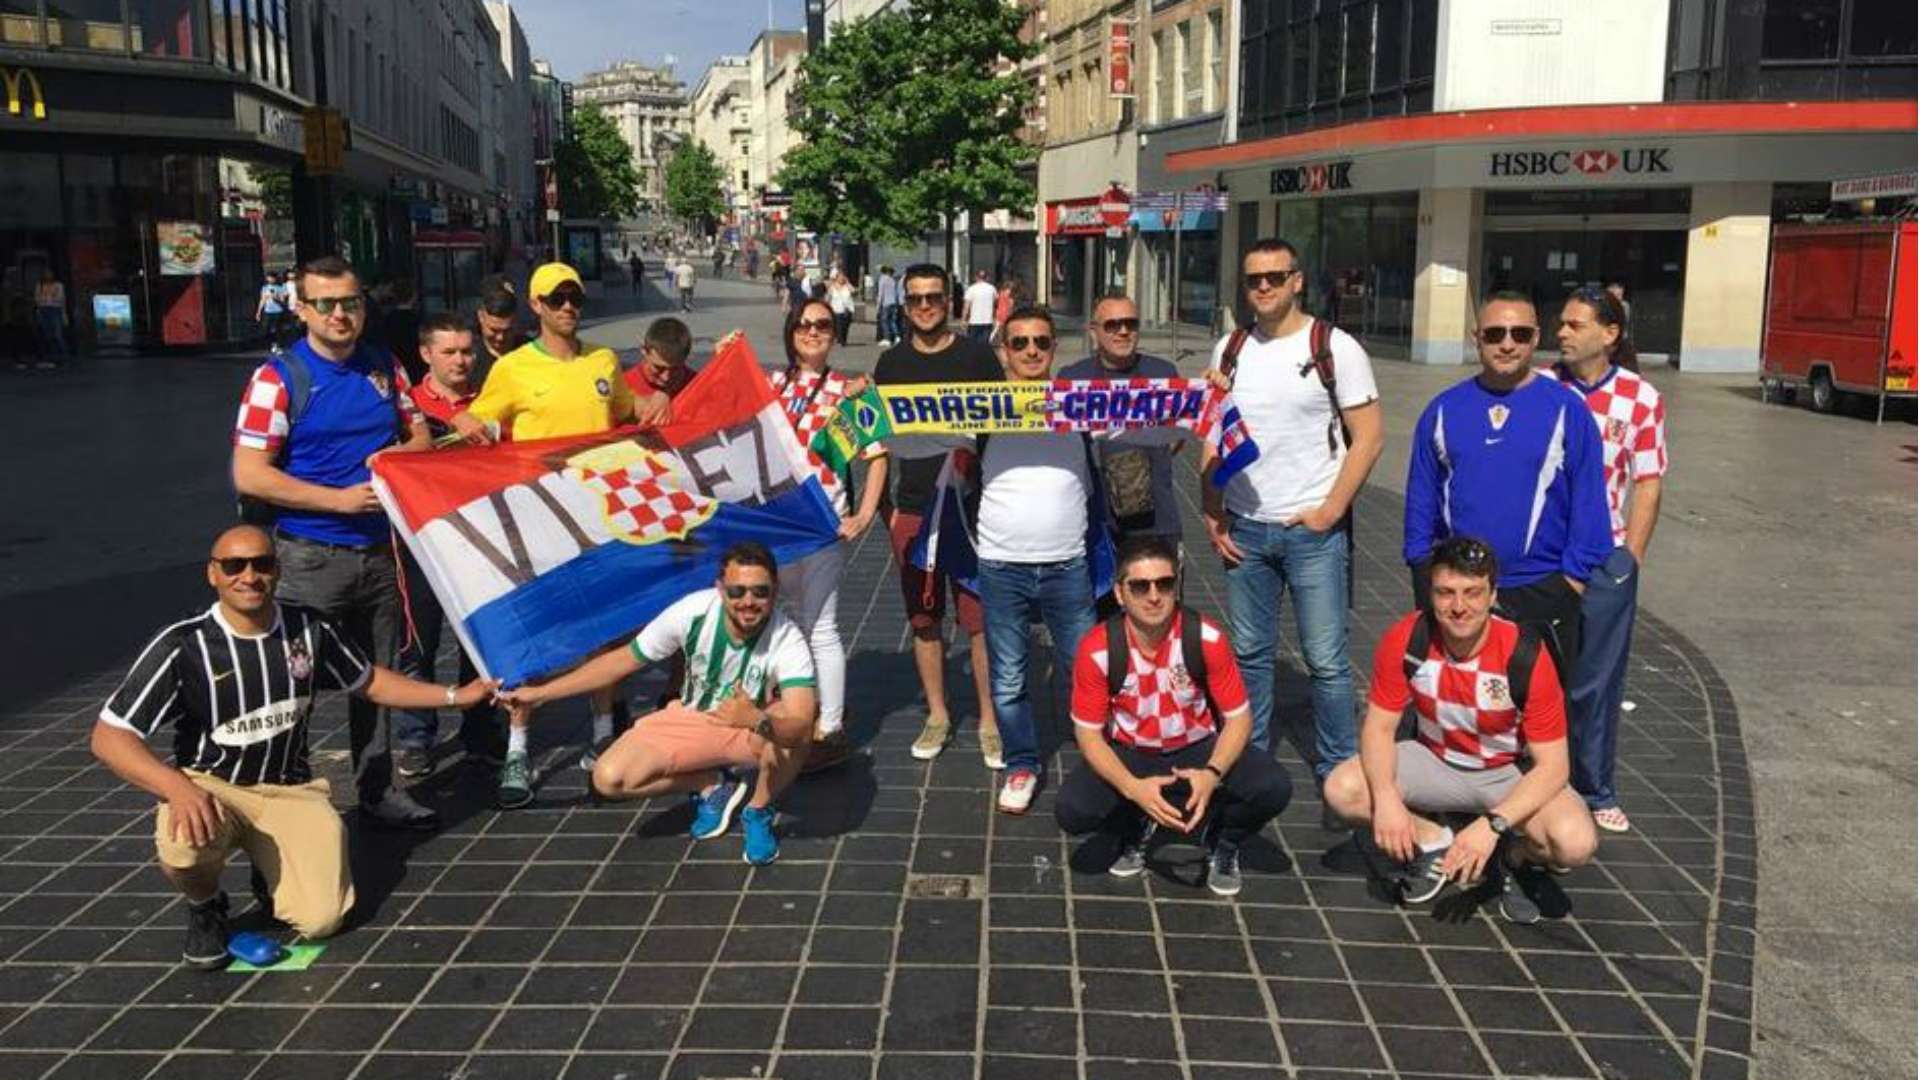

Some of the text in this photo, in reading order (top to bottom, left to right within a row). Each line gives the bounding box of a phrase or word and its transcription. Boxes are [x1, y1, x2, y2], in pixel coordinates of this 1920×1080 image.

[1270, 161, 1352, 194] HSBC UK
[1490, 148, 1671, 175] HSBC UK
[888, 394, 1022, 424] BRASIL
[1063, 389, 1204, 421] CROATIA
